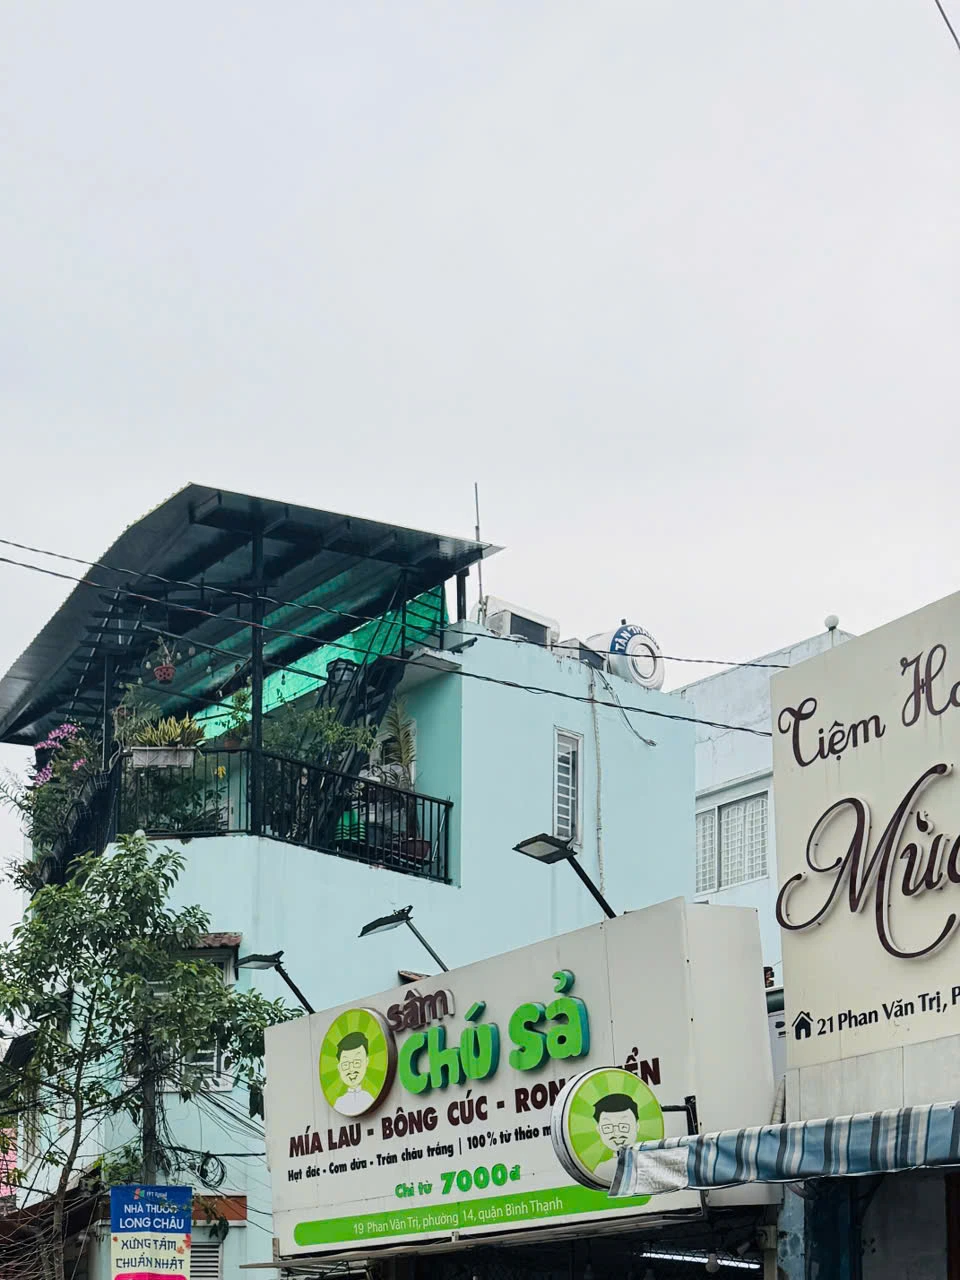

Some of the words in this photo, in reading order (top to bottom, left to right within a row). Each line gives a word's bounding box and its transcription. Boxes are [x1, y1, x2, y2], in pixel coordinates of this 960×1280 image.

[778, 697, 886, 768] Tiệm
[387, 988, 456, 1032] sâm
[817, 1016, 834, 1036] 21
[837, 1009, 879, 1031] Phan
[881, 999, 915, 1020] Văn
[917, 991, 948, 1013] Trị,
[398, 1001, 501, 1095] Chú
[289, 1125, 323, 1158] MÍA
[327, 1122, 362, 1151] LAU
[381, 1106, 438, 1141] BÔNG
[447, 1089, 488, 1126] CÚC
[514, 1077, 568, 1113] RON
[288, 1168, 303, 1183] Hạt
[466, 1131, 497, 1150] 100%
[440, 1163, 521, 1196] 7000đ
[120, 1217, 151, 1229] LONG
[152, 1215, 185, 1230] CHÂU
[124, 1202, 145, 1214] NHÀ
[353, 1222, 365, 1235] 19
[367, 1219, 389, 1233] Phan
[390, 1217, 407, 1231] Văn
[422, 1212, 459, 1230] phường
[462, 1208, 477, 1222] 14,
[478, 1205, 504, 1220] quận
[505, 1201, 529, 1216] Bình
[529, 1196, 564, 1215] Thạnh
